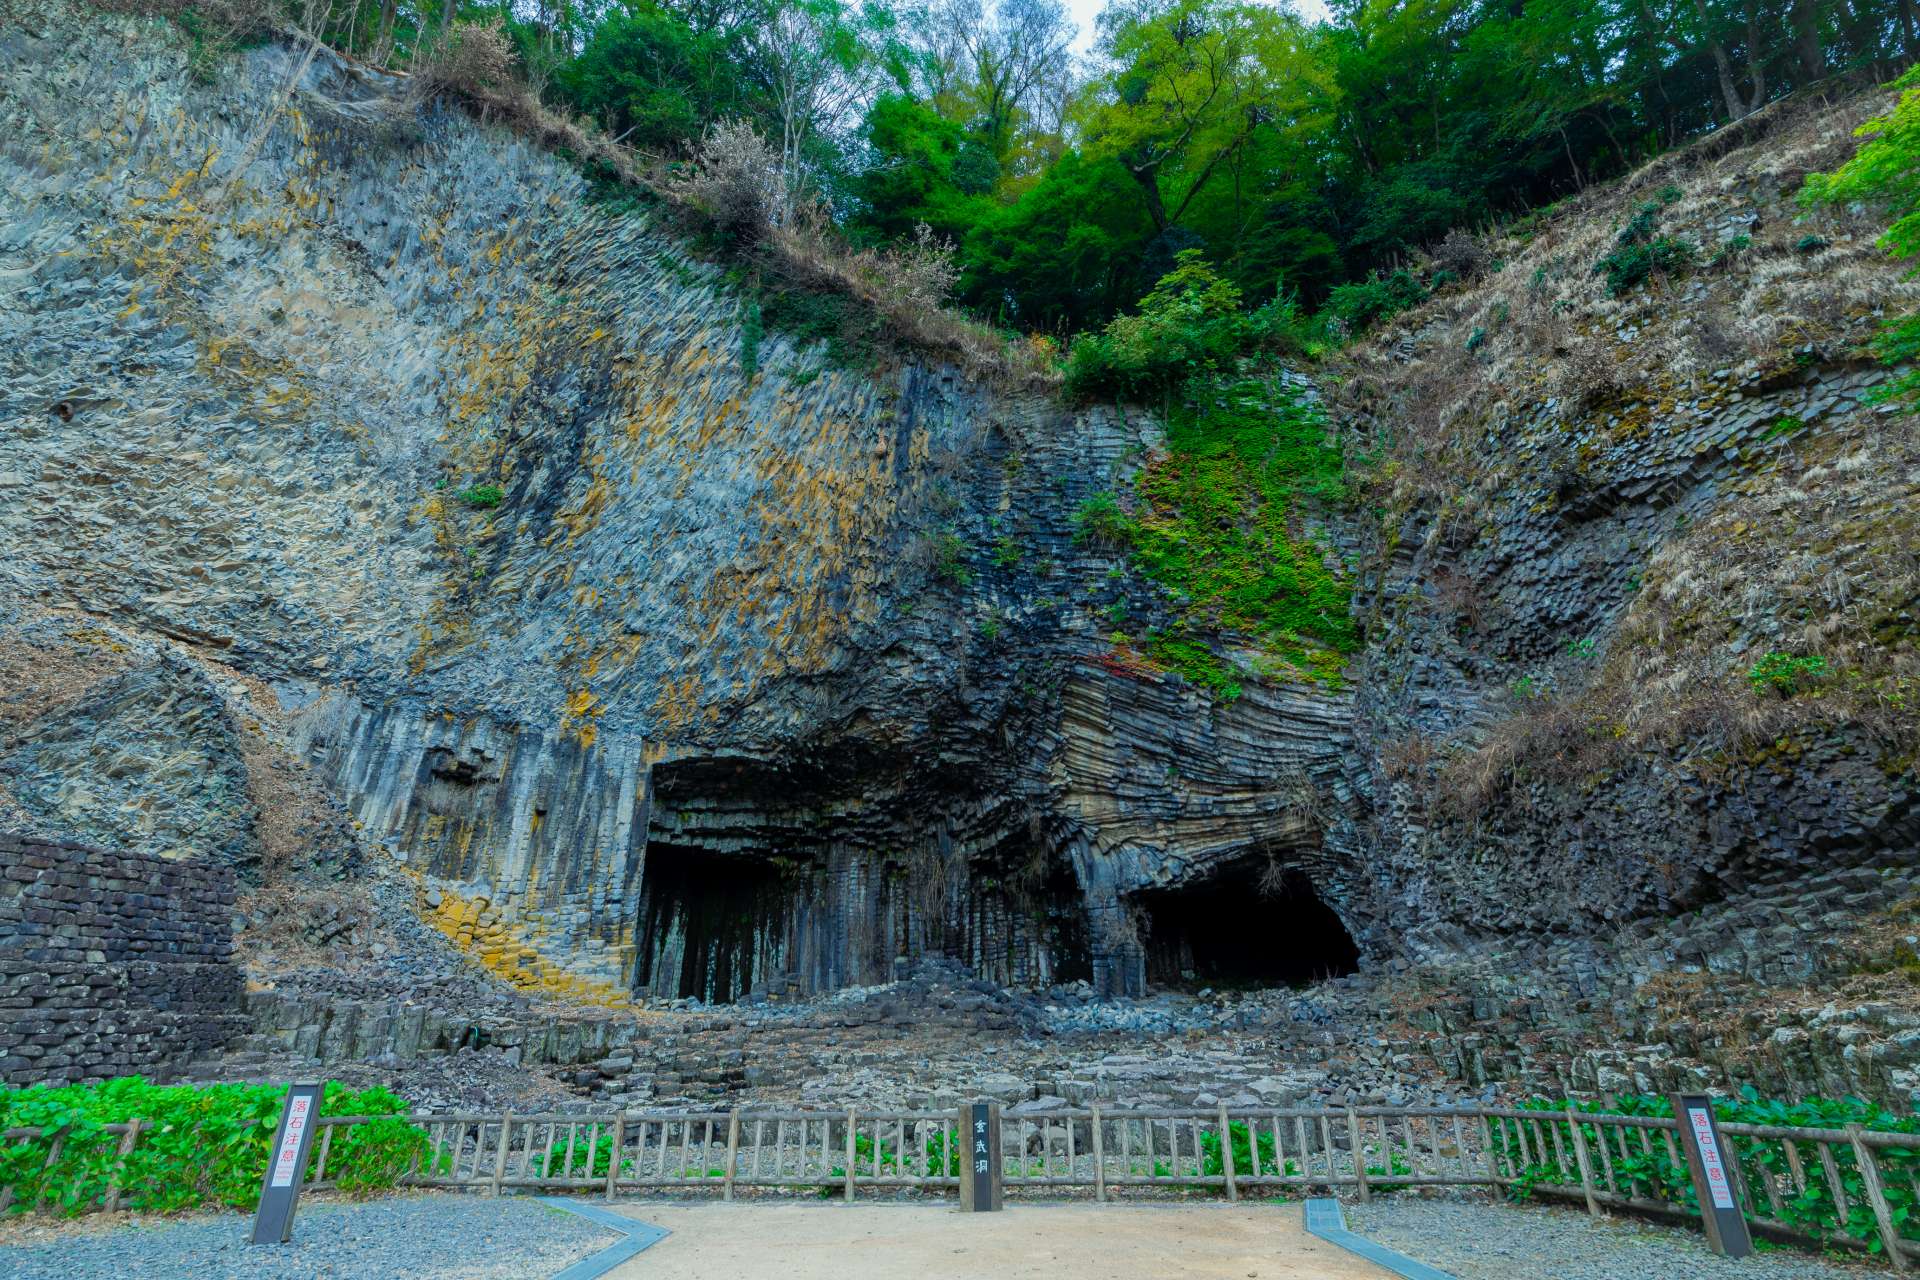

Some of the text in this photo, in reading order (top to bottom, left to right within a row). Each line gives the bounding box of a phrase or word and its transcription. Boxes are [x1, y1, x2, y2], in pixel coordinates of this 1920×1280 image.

[281, 1100, 307, 1161] 落石注意
[974, 1120, 988, 1173] 玄武洞
[1692, 1113, 1723, 1180] 落石注意
